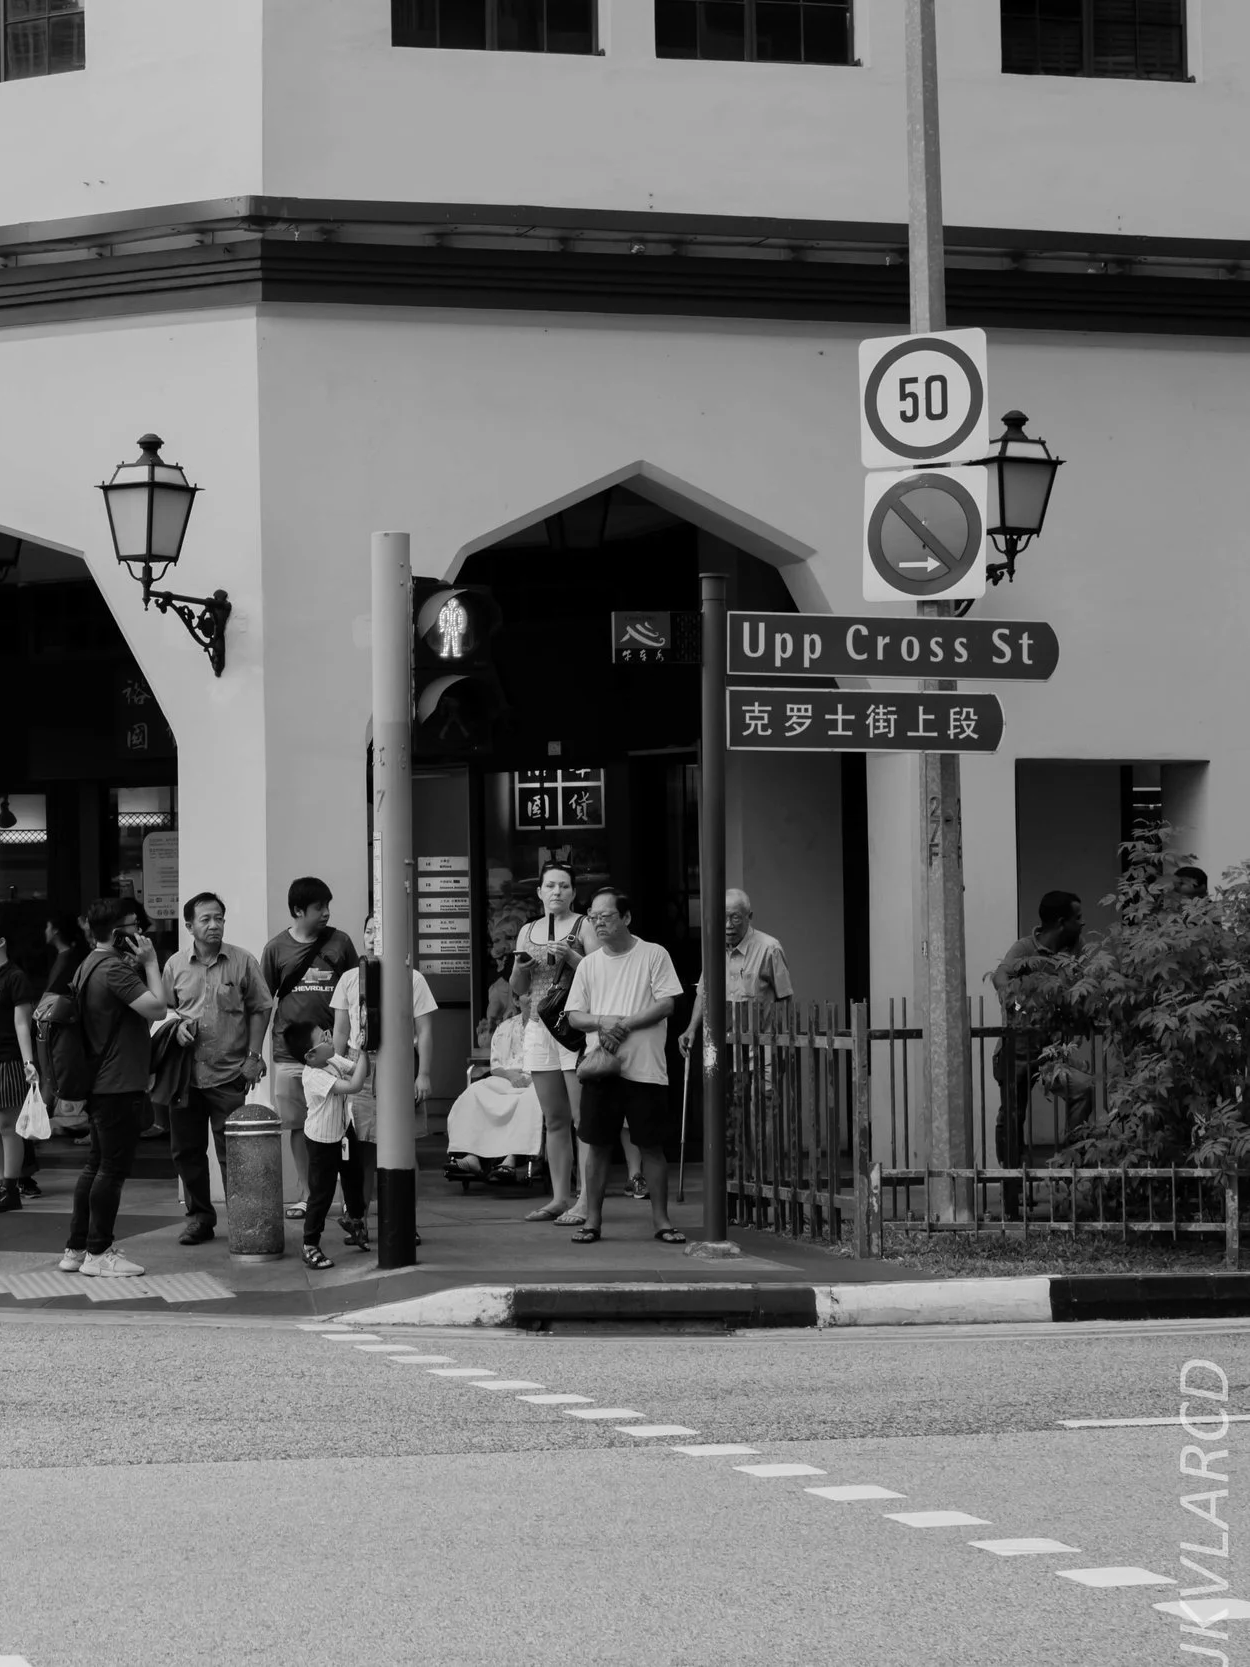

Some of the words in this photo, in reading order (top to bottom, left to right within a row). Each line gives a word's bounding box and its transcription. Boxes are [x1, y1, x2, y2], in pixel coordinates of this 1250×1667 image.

[898, 374, 949, 424] 50
[741, 621, 823, 668] Upp
[845, 624, 969, 662] Cross
[991, 628, 1034, 665] St
[741, 701, 979, 740] 克罗士街上段
